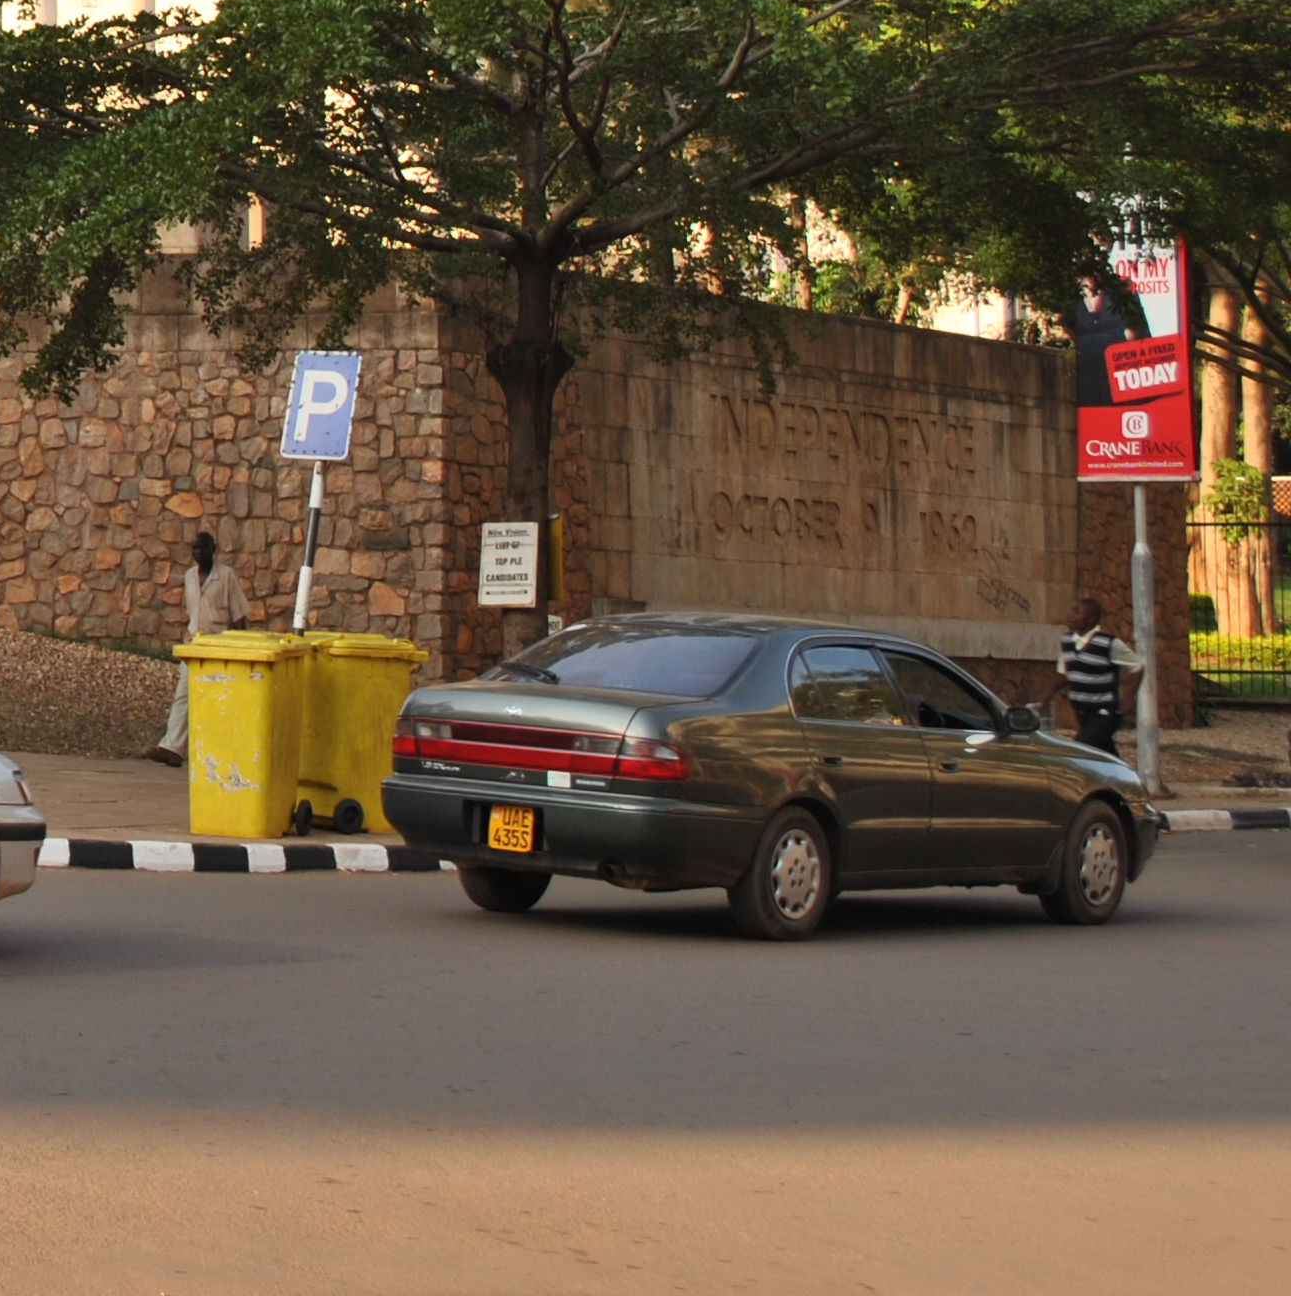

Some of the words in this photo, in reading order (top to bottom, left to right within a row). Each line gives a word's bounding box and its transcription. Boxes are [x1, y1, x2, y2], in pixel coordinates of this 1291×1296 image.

[1115, 258, 1139, 280] ON
[1144, 257, 1169, 278] MY
[1112, 349, 1137, 362] OPEN
[1140, 348, 1146, 356] A
[1113, 361, 1177, 391] TODAY
[294, 369, 348, 442] P
[709, 393, 975, 476] INDEPENDENCE
[505, 528, 528, 536] Vision
[709, 491, 844, 549] OCTOBER
[861, 502, 879, 540] 9
[919, 509, 978, 553] 1962
[495, 541, 510, 550] LIST
[495, 557, 508, 566] TOP
[510, 556, 523, 566] PLE
[485, 573, 529, 582] CANDIDATES
[502, 806, 531, 828] UAE
[493, 827, 530, 849] 435S
